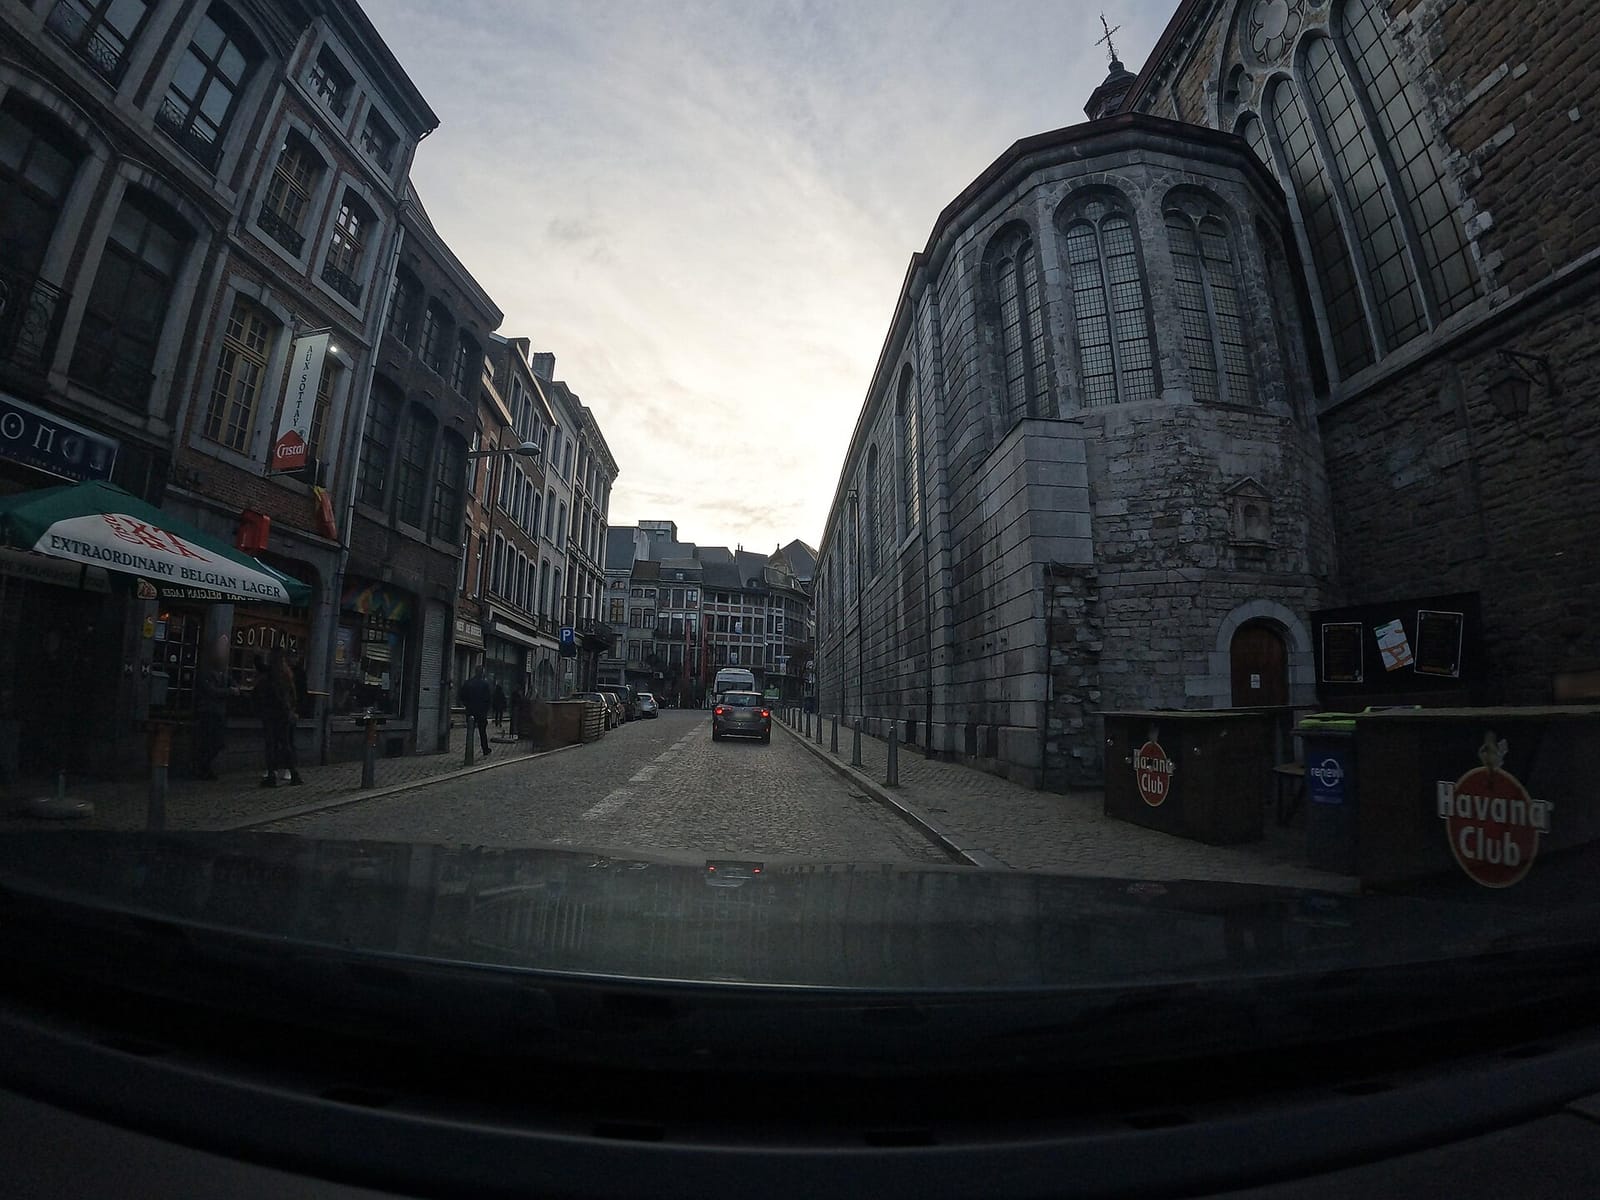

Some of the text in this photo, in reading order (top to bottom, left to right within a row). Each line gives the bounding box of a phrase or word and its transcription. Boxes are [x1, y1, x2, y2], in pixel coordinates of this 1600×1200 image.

[293, 374, 308, 427] SOTTAY
[276, 443, 305, 459] Cristal
[51, 534, 174, 576] EXTRAORDINARY
[181, 561, 237, 589] BELGIAN
[242, 579, 281, 598] LAGER
[562, 629, 571, 641] P
[1141, 773, 1164, 794] Club
[1437, 781, 1551, 833] Havana
[1459, 826, 1521, 867] Club
